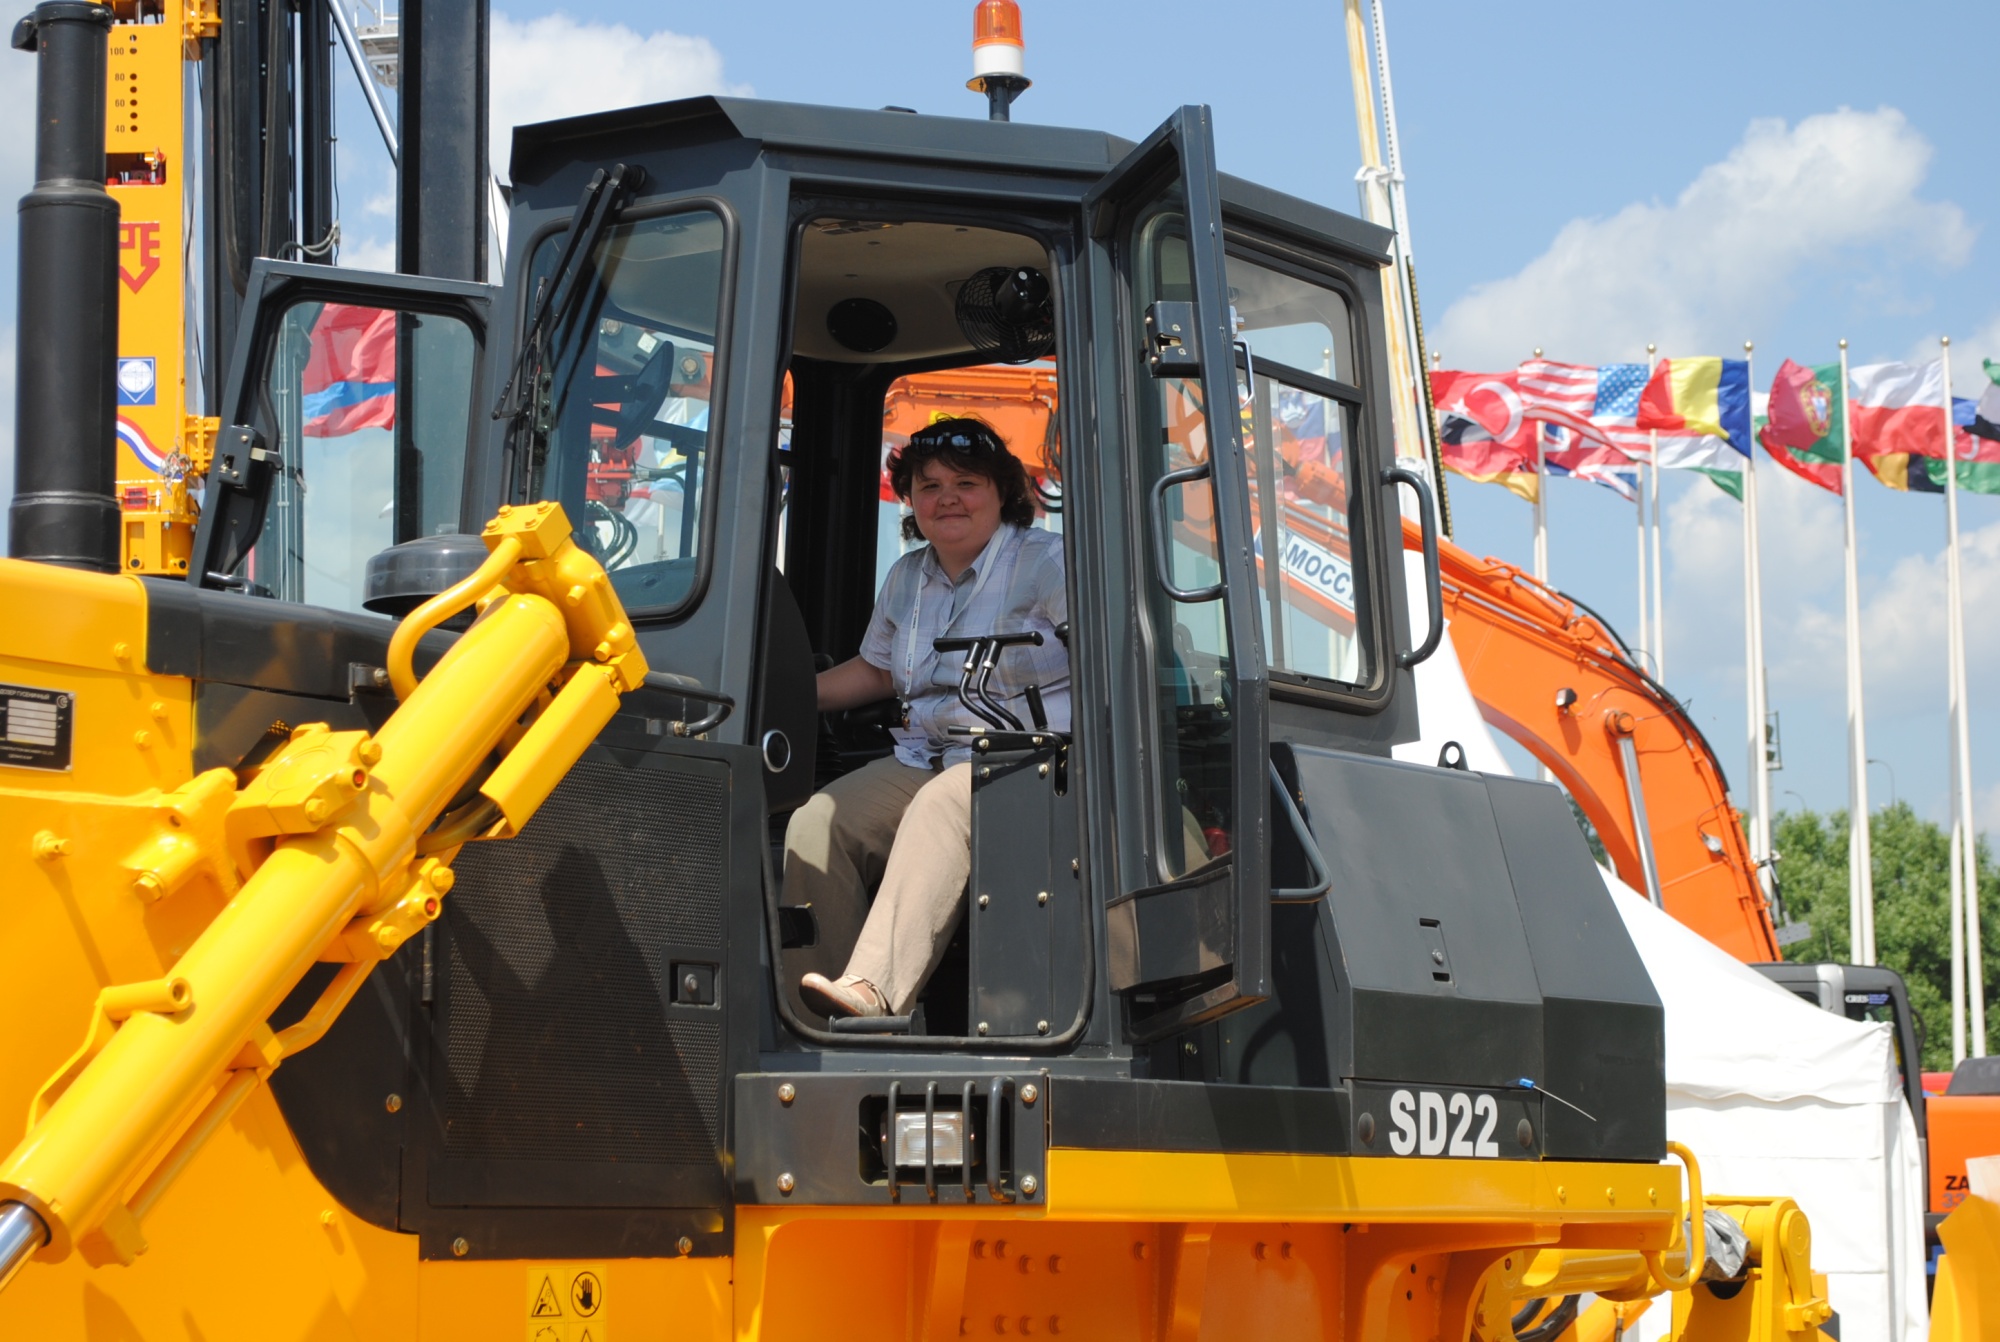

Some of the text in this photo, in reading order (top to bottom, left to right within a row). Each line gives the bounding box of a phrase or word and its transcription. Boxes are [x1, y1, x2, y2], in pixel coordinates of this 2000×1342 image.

[109, 47, 124, 56] 100
[114, 73, 125, 82] 80
[114, 99, 125, 108] 60
[114, 125, 125, 134] 40
[1287, 543, 1354, 601] МОСС
[1388, 1089, 1499, 1158] SD22
